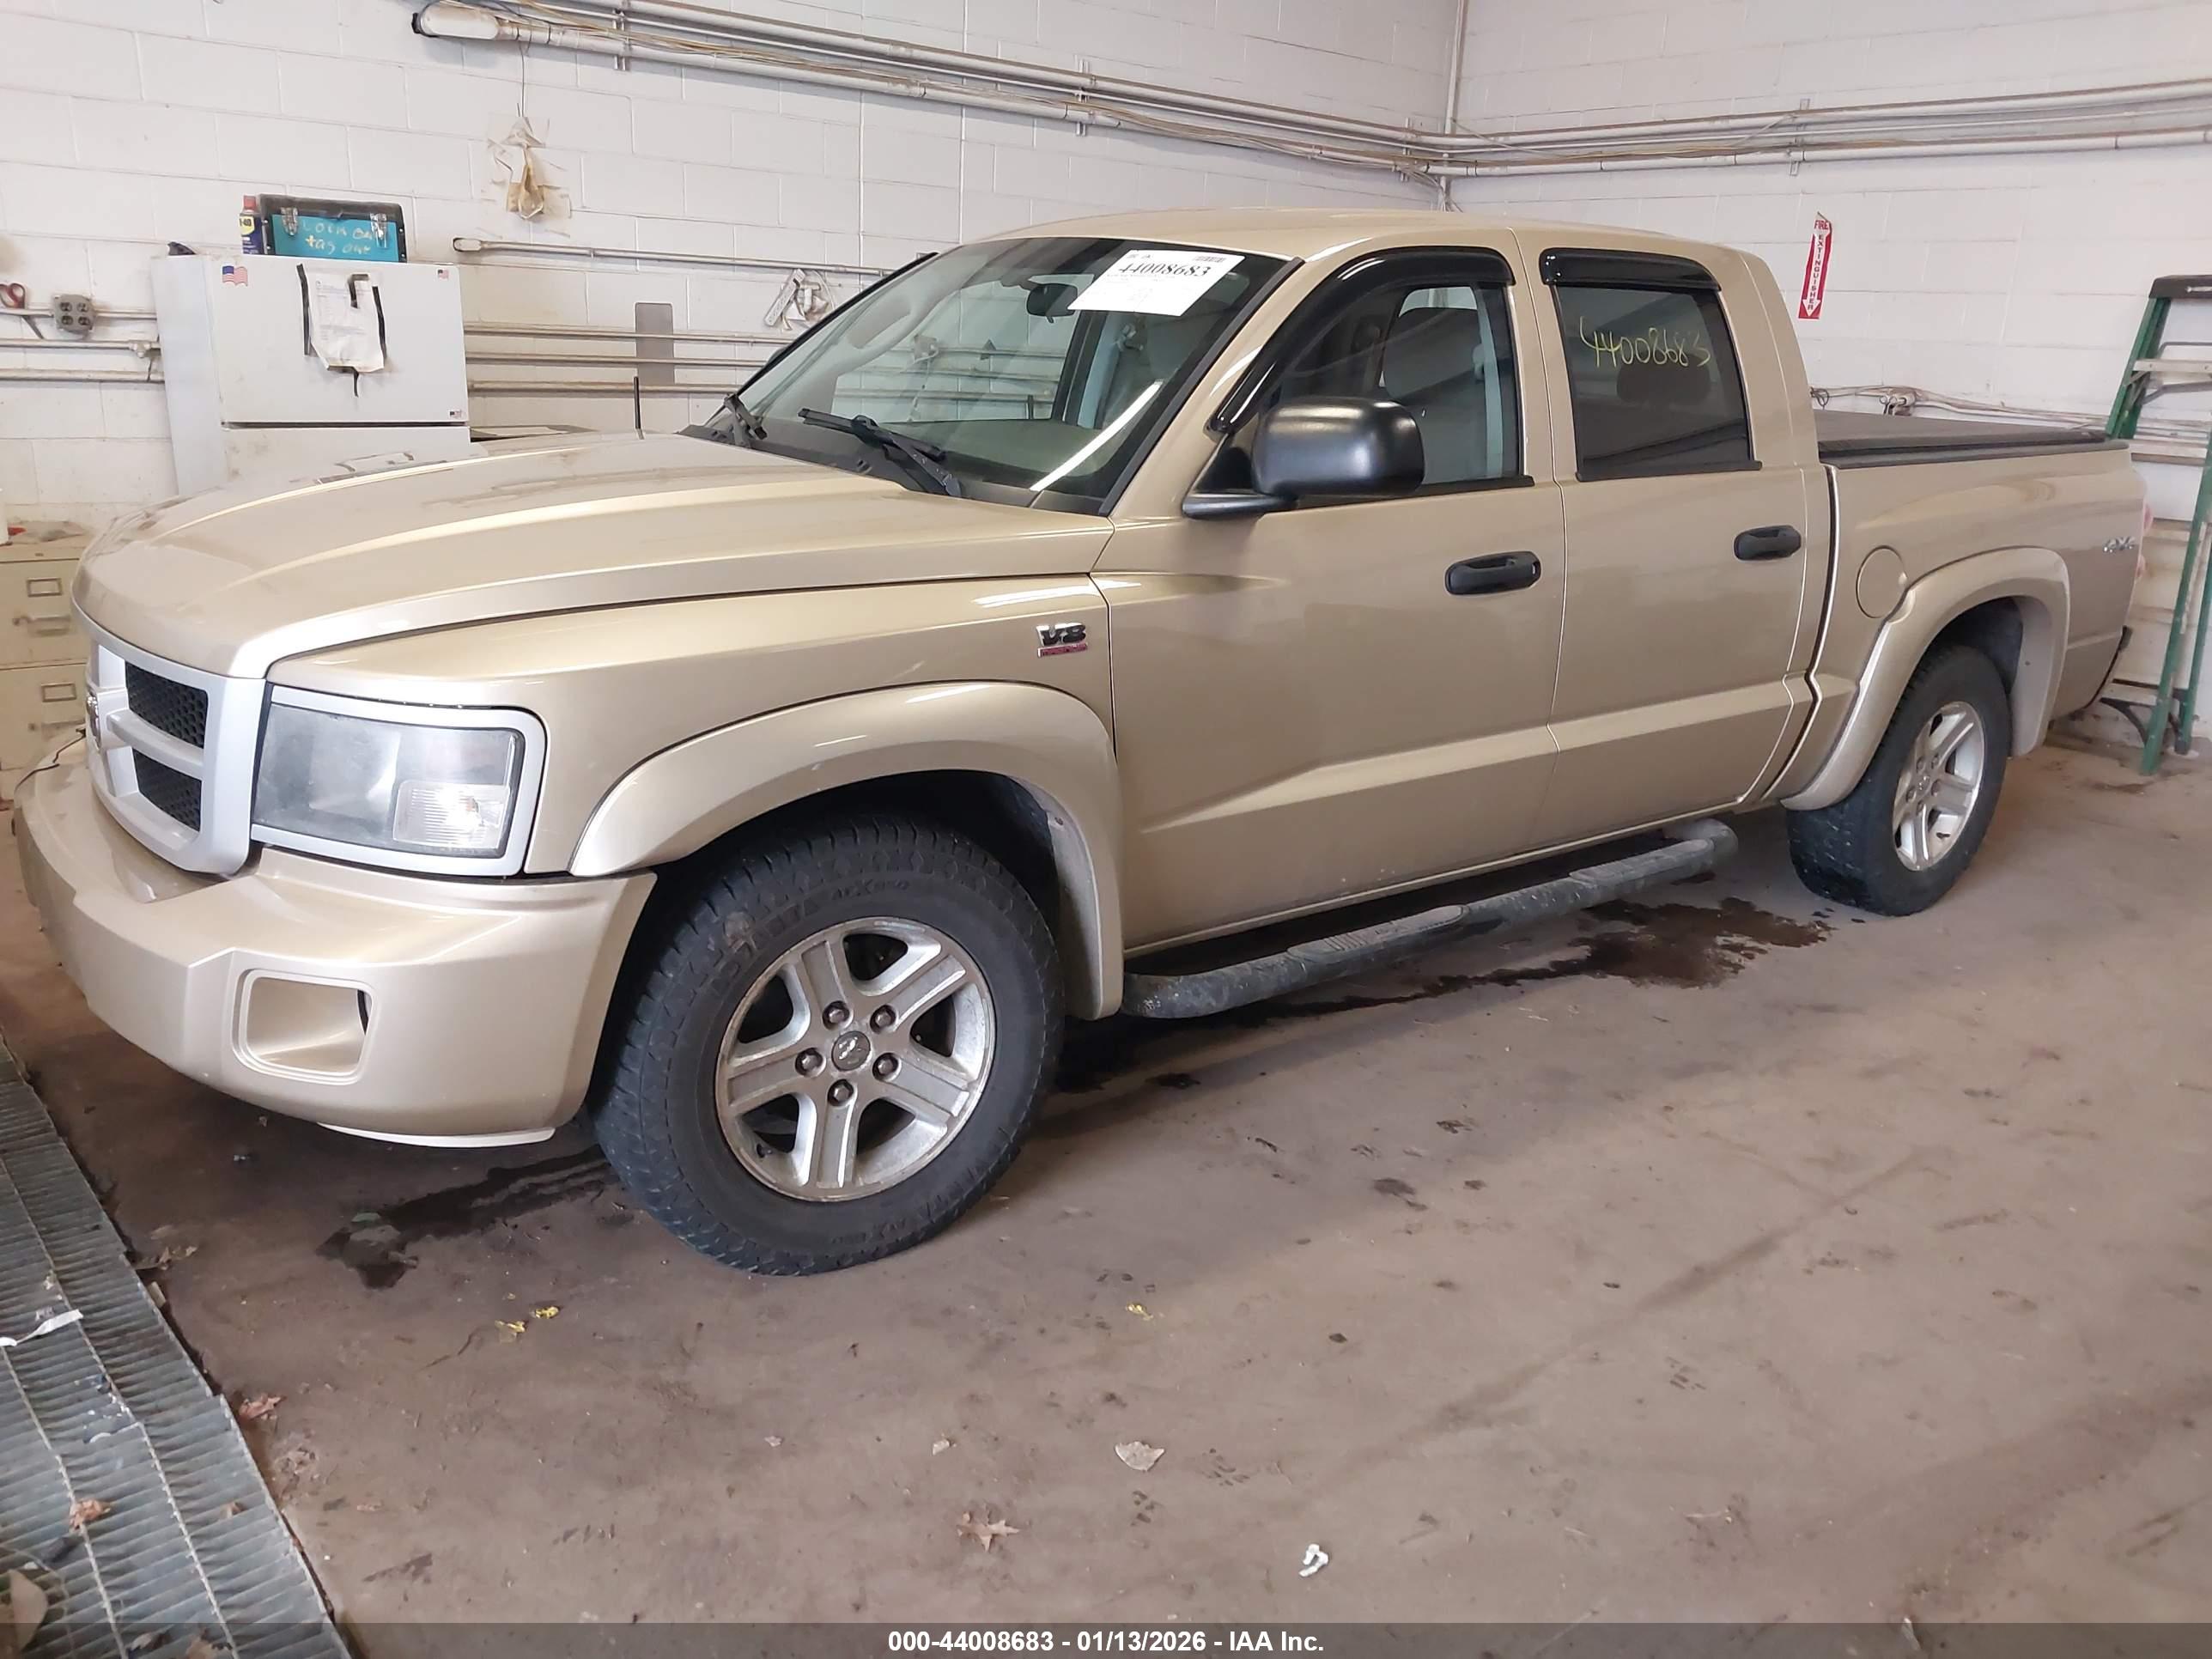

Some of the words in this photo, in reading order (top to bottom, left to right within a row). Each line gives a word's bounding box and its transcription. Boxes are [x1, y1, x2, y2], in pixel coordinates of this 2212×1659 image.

[1814, 220, 1829, 230] FIRE
[1118, 262, 1212, 276] 44008683
[1808, 234, 1824, 311] EXTINGUISHER
[1579, 315, 1711, 368] 44008683
